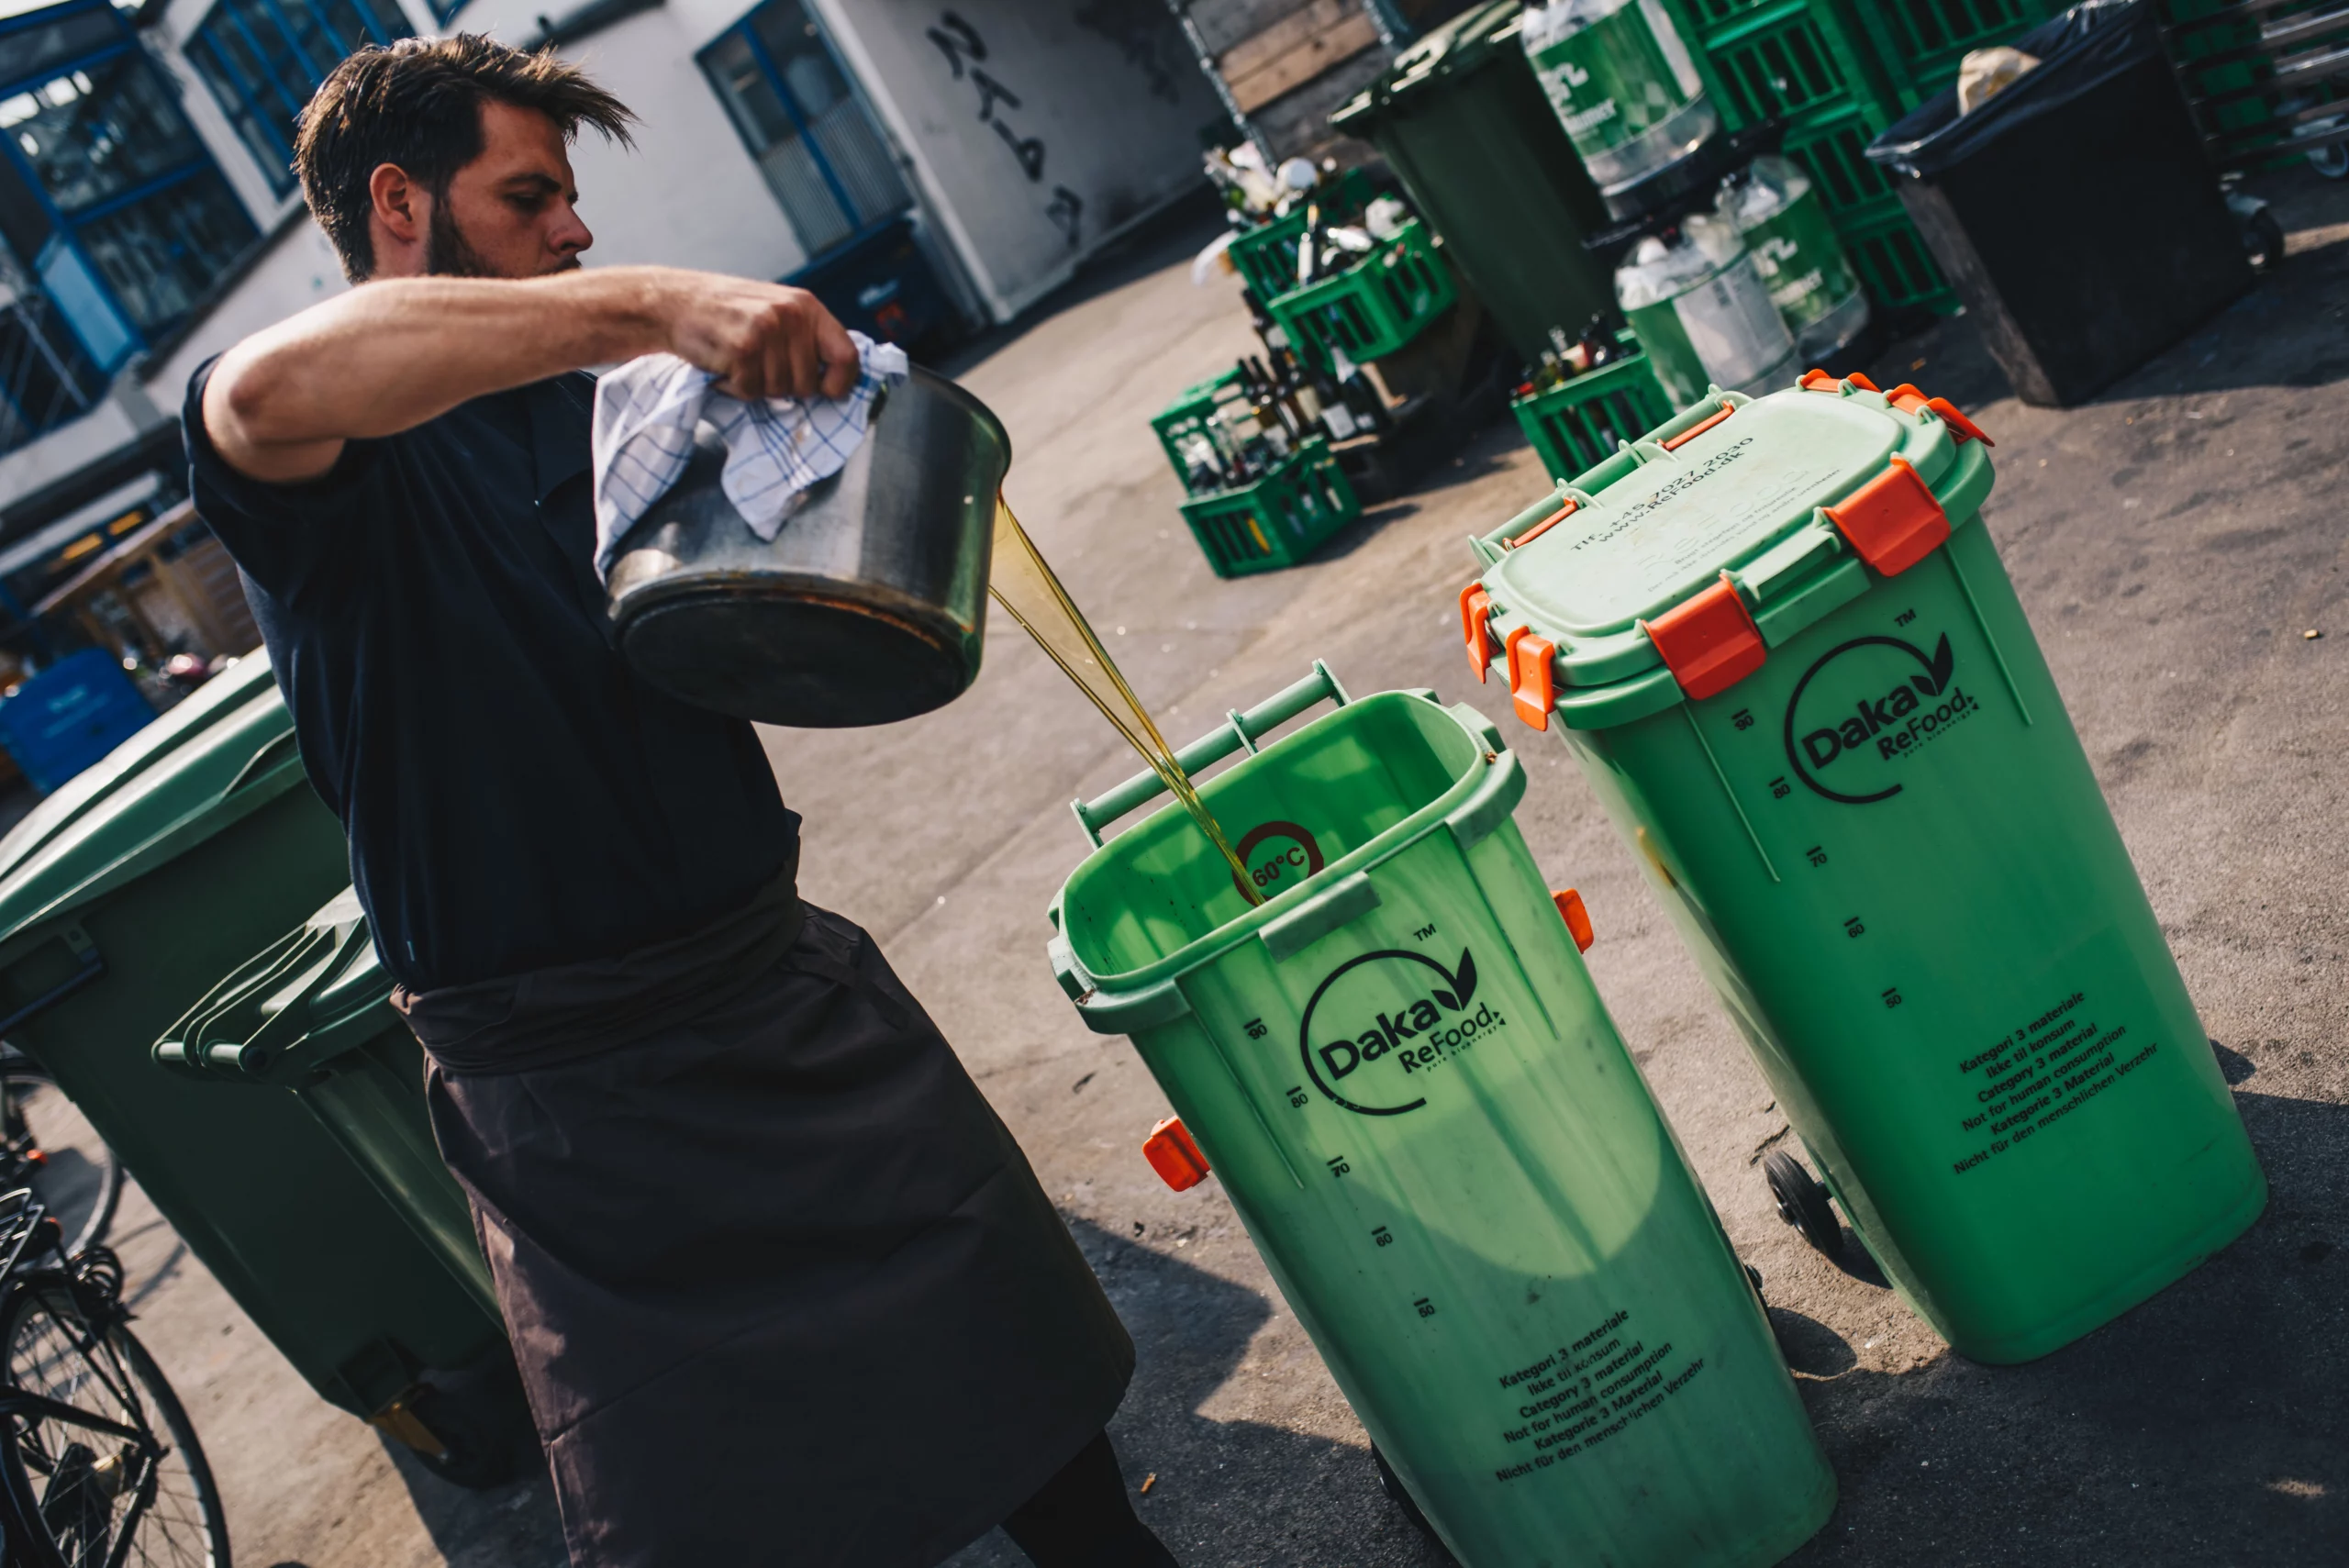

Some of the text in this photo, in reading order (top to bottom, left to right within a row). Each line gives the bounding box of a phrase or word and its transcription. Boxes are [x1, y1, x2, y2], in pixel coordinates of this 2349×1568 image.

[1570, 437, 1753, 551] Tlf. +45 7027 2030
[1598, 450, 1745, 543] www.ReFood.dk
[1800, 685, 1920, 770] Daka
[1876, 686, 1966, 761] ReFood
[1904, 710, 1970, 758] pure bioenergy
[1773, 784, 1791, 799] 80
[1252, 847, 1306, 887] 60°C
[1809, 852, 1828, 868] 70
[1848, 923, 1865, 939] 60
[1248, 1024, 1268, 1040] 90
[1398, 1002, 1493, 1073] ReFood
[1885, 994, 1902, 1009] 50
[1959, 992, 2085, 1073] Kategori 3 materiale
[1318, 999, 1442, 1081] Daka
[1427, 1025, 1497, 1073] pure bioenergy
[1977, 1022, 2098, 1103] Category 3 material
[1985, 1019, 2076, 1079] Ikke til konsum
[1291, 1093, 1308, 1108] 80
[1953, 1042, 2157, 1174] Nicht für den menschlichen Verzehr
[1961, 1026, 2126, 1131] Not for human consumption
[1990, 1051, 2114, 1135] Kategorie 3 Material
[1331, 1162, 1351, 1178] 70
[1376, 1233, 1394, 1248] 60
[1418, 1304, 1435, 1318] 50
[1498, 1309, 1629, 1389] Kategori 3 materiale
[1519, 1340, 1643, 1418] Category 3 material
[1527, 1377, 1555, 1396] Ikke
[1556, 1366, 1572, 1382] til
[1495, 1462, 1533, 1482] Nicht
[1533, 1454, 1554, 1469] für
[1558, 1443, 1582, 1461] den
[1664, 1358, 1704, 1395] Verzehr
[1502, 1342, 1672, 1443] Not for human consumption
[1533, 1369, 1665, 1451] Kategorie 3 Material
